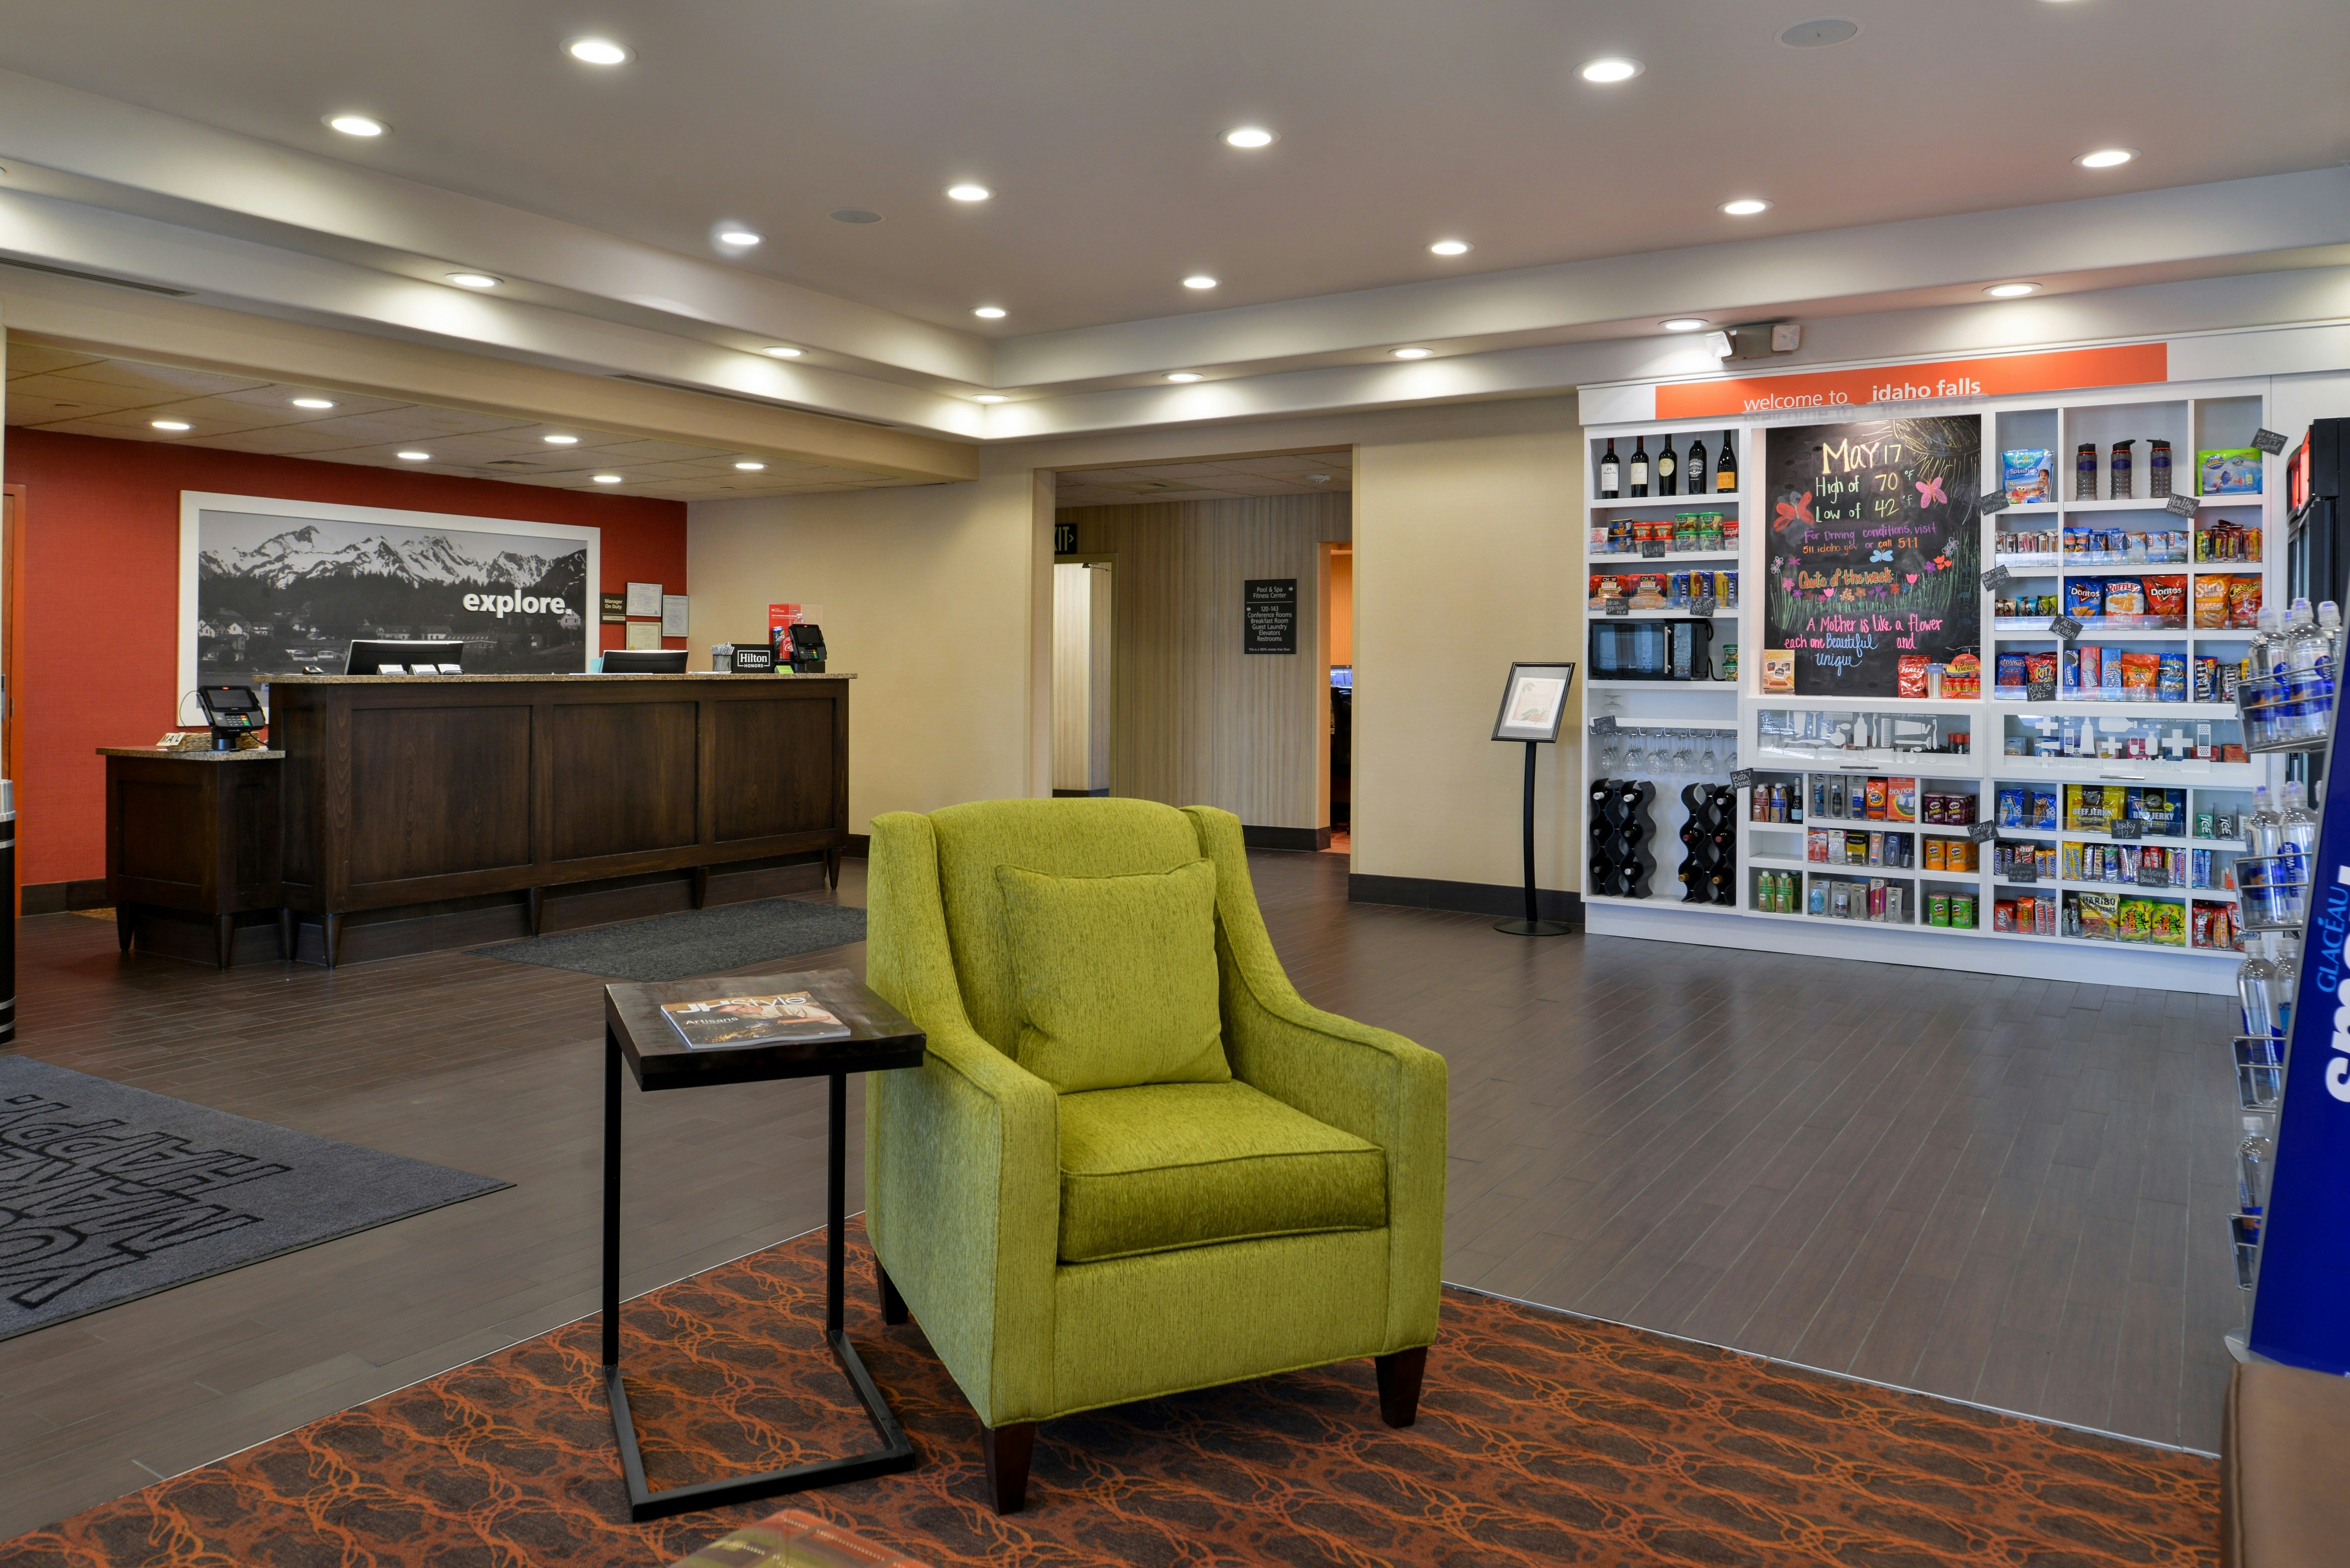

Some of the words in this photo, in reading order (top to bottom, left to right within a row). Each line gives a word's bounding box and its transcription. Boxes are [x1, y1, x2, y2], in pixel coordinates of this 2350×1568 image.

[1744, 393, 1822, 411] welcome
[1829, 390, 1848, 405] to
[1872, 383, 1931, 401] idaho
[1936, 377, 1981, 396] falls
[2256, 437, 2278, 445] BUTT
[1884, 444, 1901, 464] 17
[1816, 476, 1844, 504] High
[1848, 475, 1860, 492] of
[1875, 472, 1899, 491] 70
[1816, 506, 1840, 522] Low
[1849, 502, 1861, 519] of
[1874, 499, 1899, 518] 42
[1054, 526, 1069, 551] XIT
[1804, 530, 1821, 544] For
[1824, 531, 1855, 545] Driving
[1862, 524, 1912, 538] conditions,
[1915, 522, 1937, 534] visit
[1878, 539, 1893, 548] call
[1798, 570, 1827, 590] Quote
[1830, 568, 1841, 586] of
[1842, 569, 1864, 585] the
[2071, 587, 2100, 597] Doritos
[2107, 583, 2140, 593] RUFFLES
[2151, 587, 2182, 596] Doritos
[2229, 581, 2260, 599] Cheetos
[463, 589, 573, 619] explore.
[1806, 617, 1815, 631] A
[1820, 614, 1856, 632] Mother
[1860, 618, 1870, 633] is
[1872, 614, 1892, 631] like
[1896, 620, 1905, 631] a
[1908, 614, 1943, 632] flower
[1784, 634, 1807, 649] each
[1810, 638, 1826, 649] one
[1897, 632, 1917, 649] and
[740, 653, 767, 662] Hilton
[2035, 667, 2053, 679] RITZ
[2028, 683, 2046, 694] Ritz
[1732, 774, 1749, 782] BOTA
[1870, 794, 1882, 803] Tide
[2152, 812, 2174, 821] JERKY
[1969, 824, 1993, 837] Candy
[2112, 821, 2136, 833] Jerky
[2200, 817, 2211, 834] ICE
[2220, 817, 2233, 835] ICE
[2072, 849, 2080, 879] Butterfinger
[2083, 896, 2115, 906] HARIBO
[2127, 911, 2136, 933] PATCH
[2135, 910, 2144, 932] SOUR
[2170, 915, 2179, 935] SOUR
[2197, 915, 2207, 944] Skittles
[2315, 886, 2349, 994] GLACÉAU
[686, 1017, 738, 1025] Artisans
